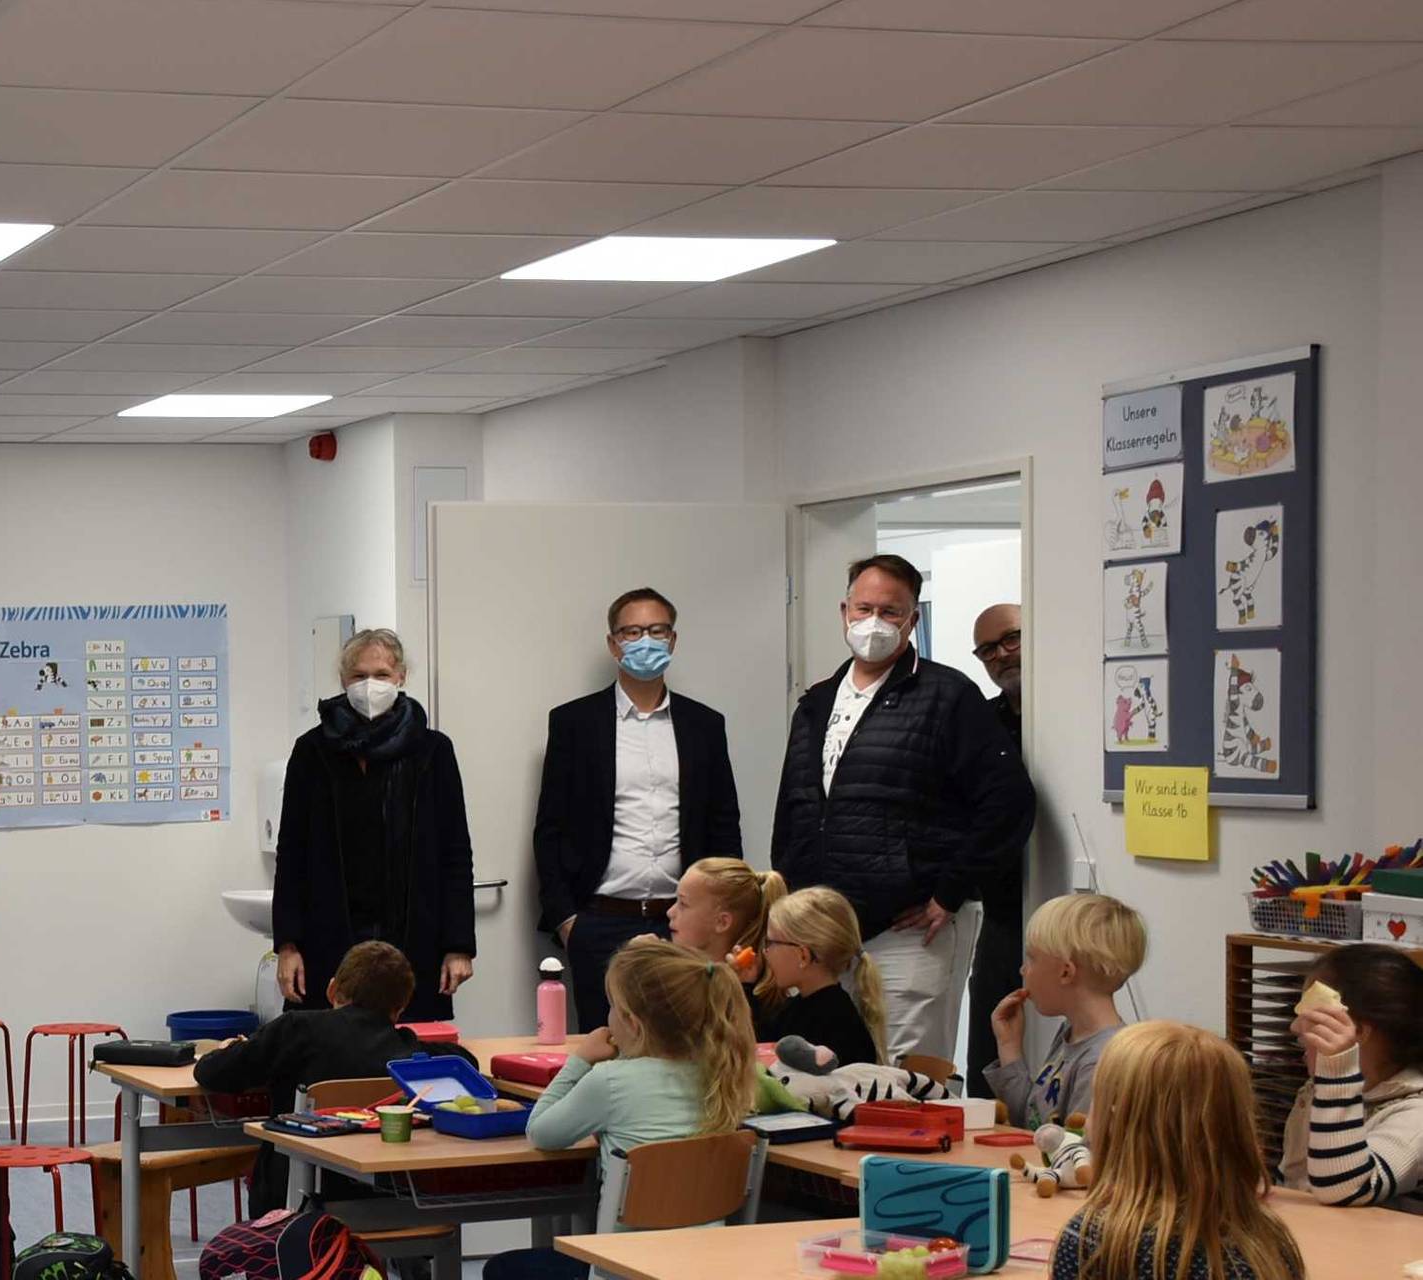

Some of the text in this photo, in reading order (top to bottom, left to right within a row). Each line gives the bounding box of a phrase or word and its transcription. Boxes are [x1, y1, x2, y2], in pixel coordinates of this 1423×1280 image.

[1122, 406, 1157, 422] Unsere
[1106, 428, 1177, 453] Klassenregeln
[0, 640, 50, 658] Zebra
[1156, 780, 1177, 796] sind
[1180, 781, 1198, 796] die
[1142, 802, 1188, 818] Klasse 1b
